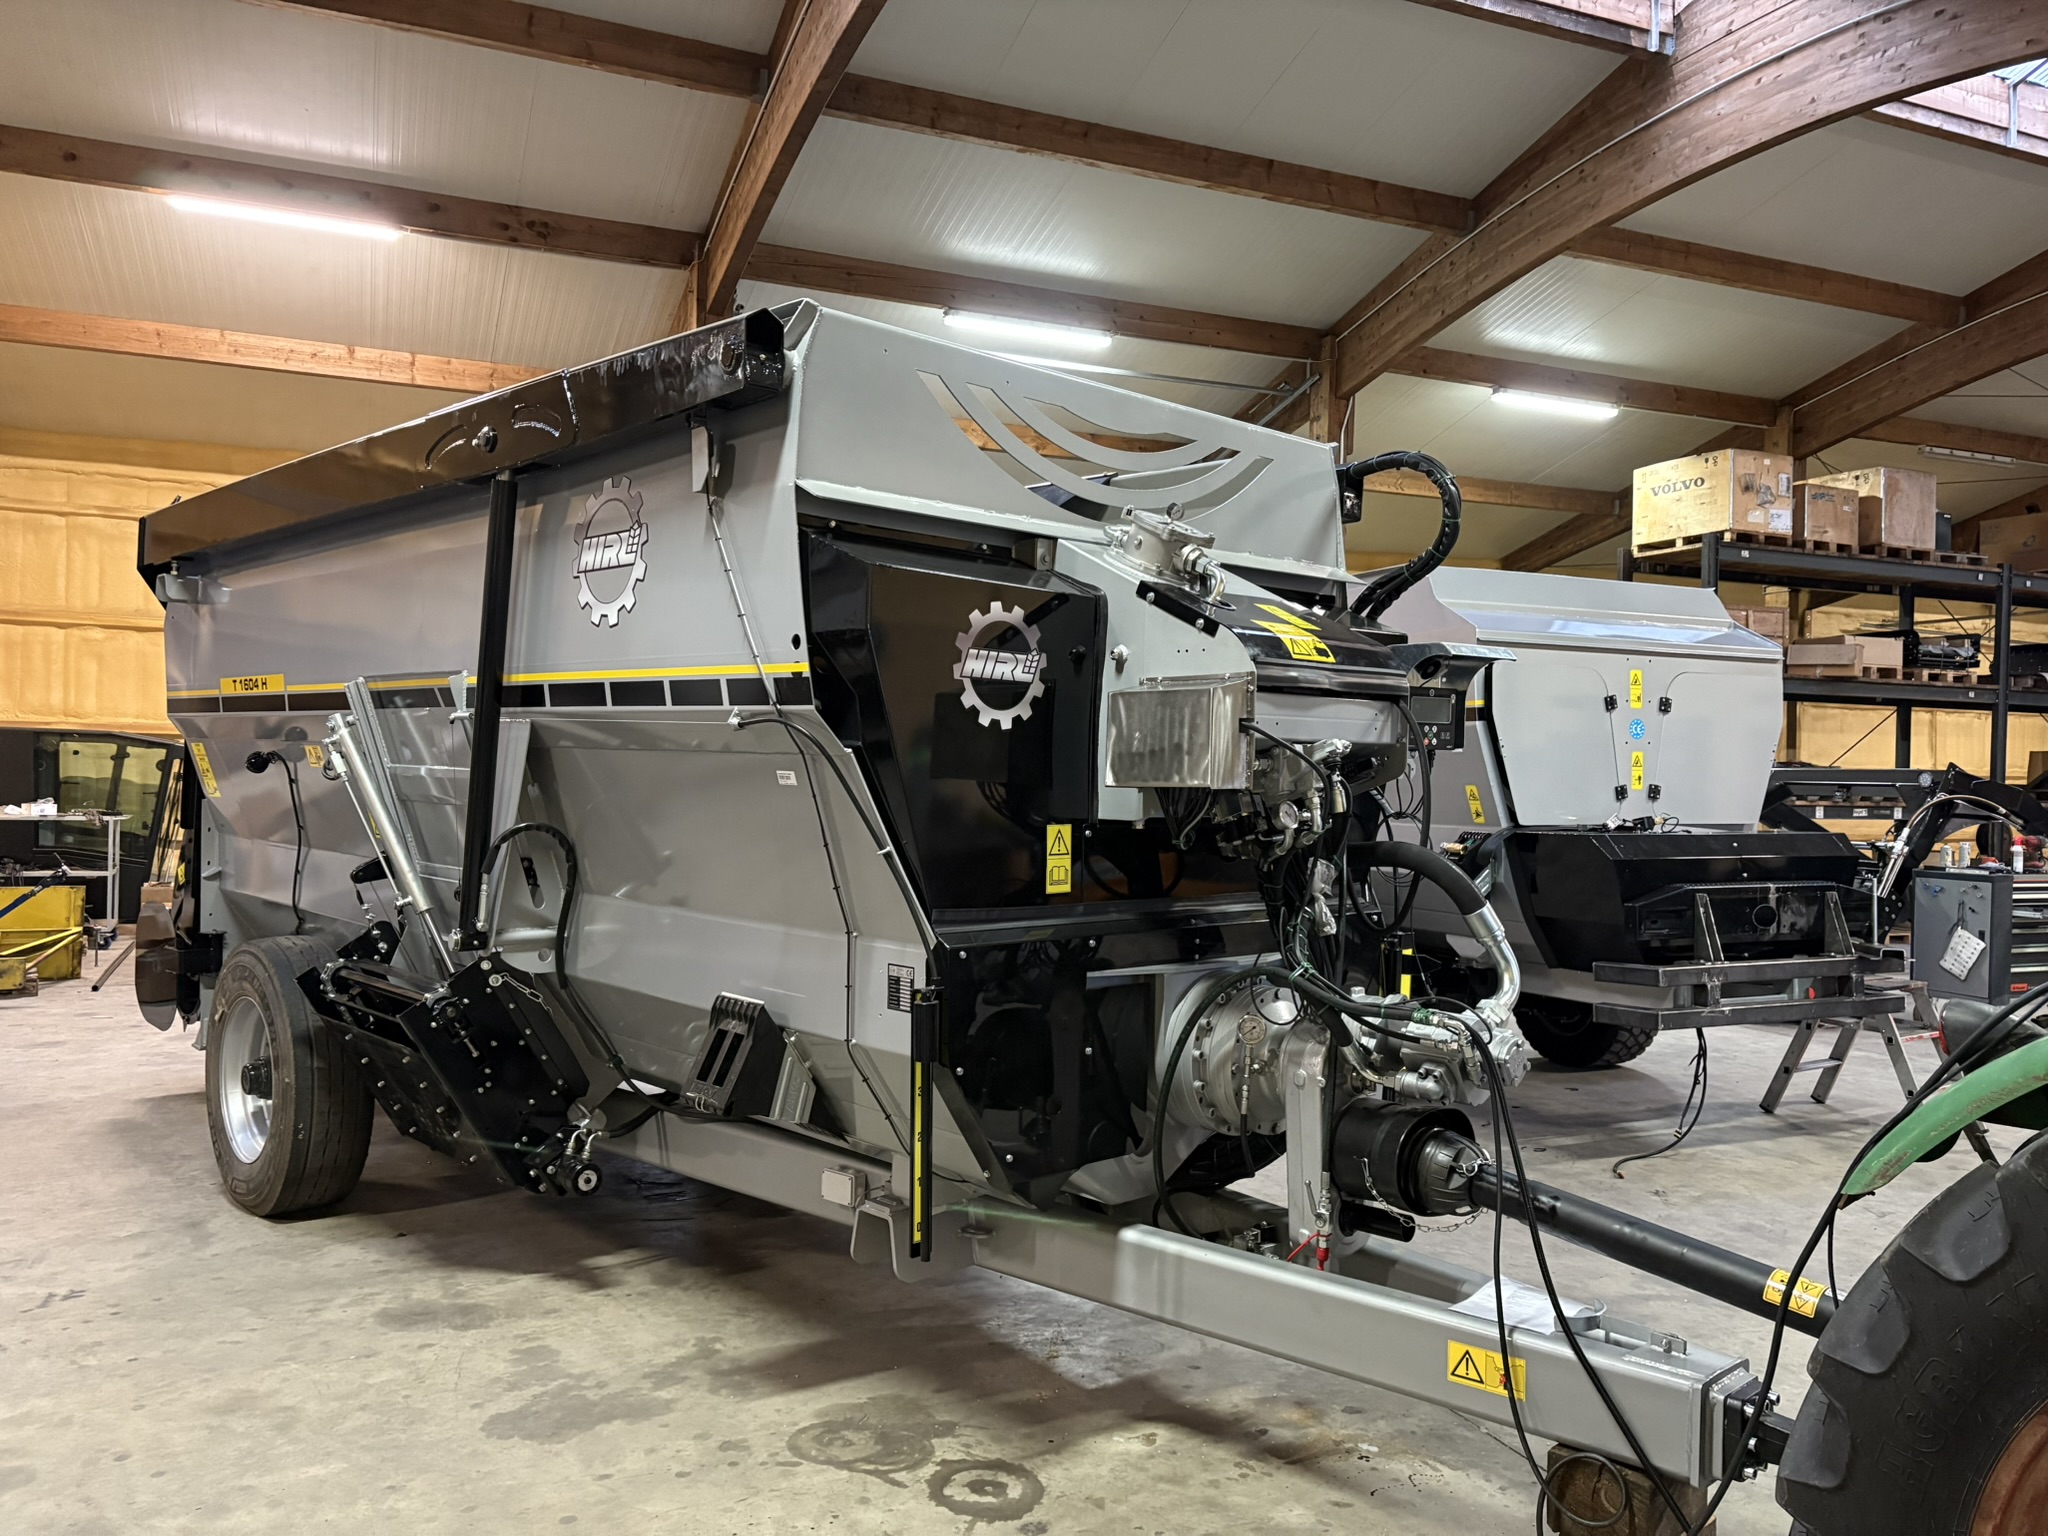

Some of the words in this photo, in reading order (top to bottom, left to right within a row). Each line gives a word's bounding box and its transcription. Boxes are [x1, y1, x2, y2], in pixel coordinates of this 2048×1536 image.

[1650, 477, 1705, 497] VOLVO
[232, 680, 238, 692] T
[239, 678, 260, 691] 1604
[261, 677, 268, 690] H
